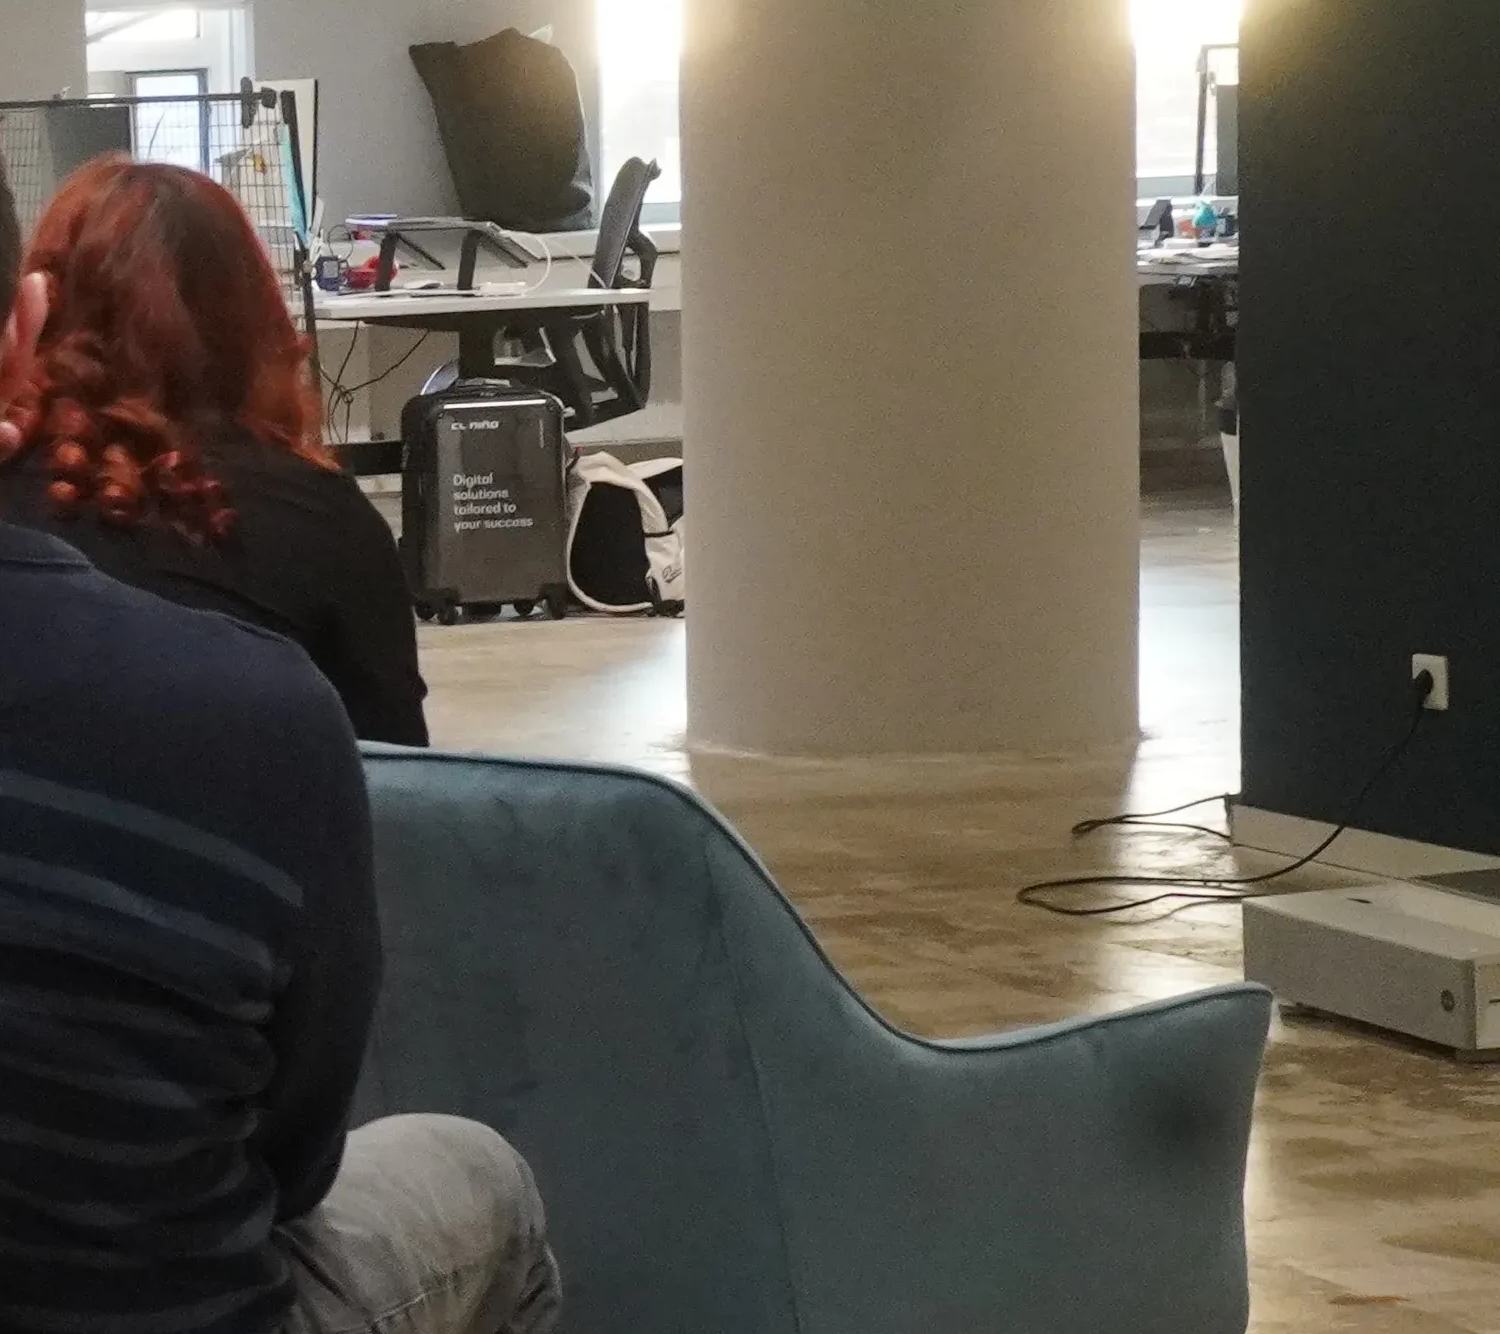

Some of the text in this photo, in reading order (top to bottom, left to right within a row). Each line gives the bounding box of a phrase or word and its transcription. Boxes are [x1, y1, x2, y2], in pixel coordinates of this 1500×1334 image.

[453, 472, 493, 488] Digital
[453, 489, 509, 501] solutions
[454, 502, 517, 516] tailored to
[454, 518, 534, 534] your success
